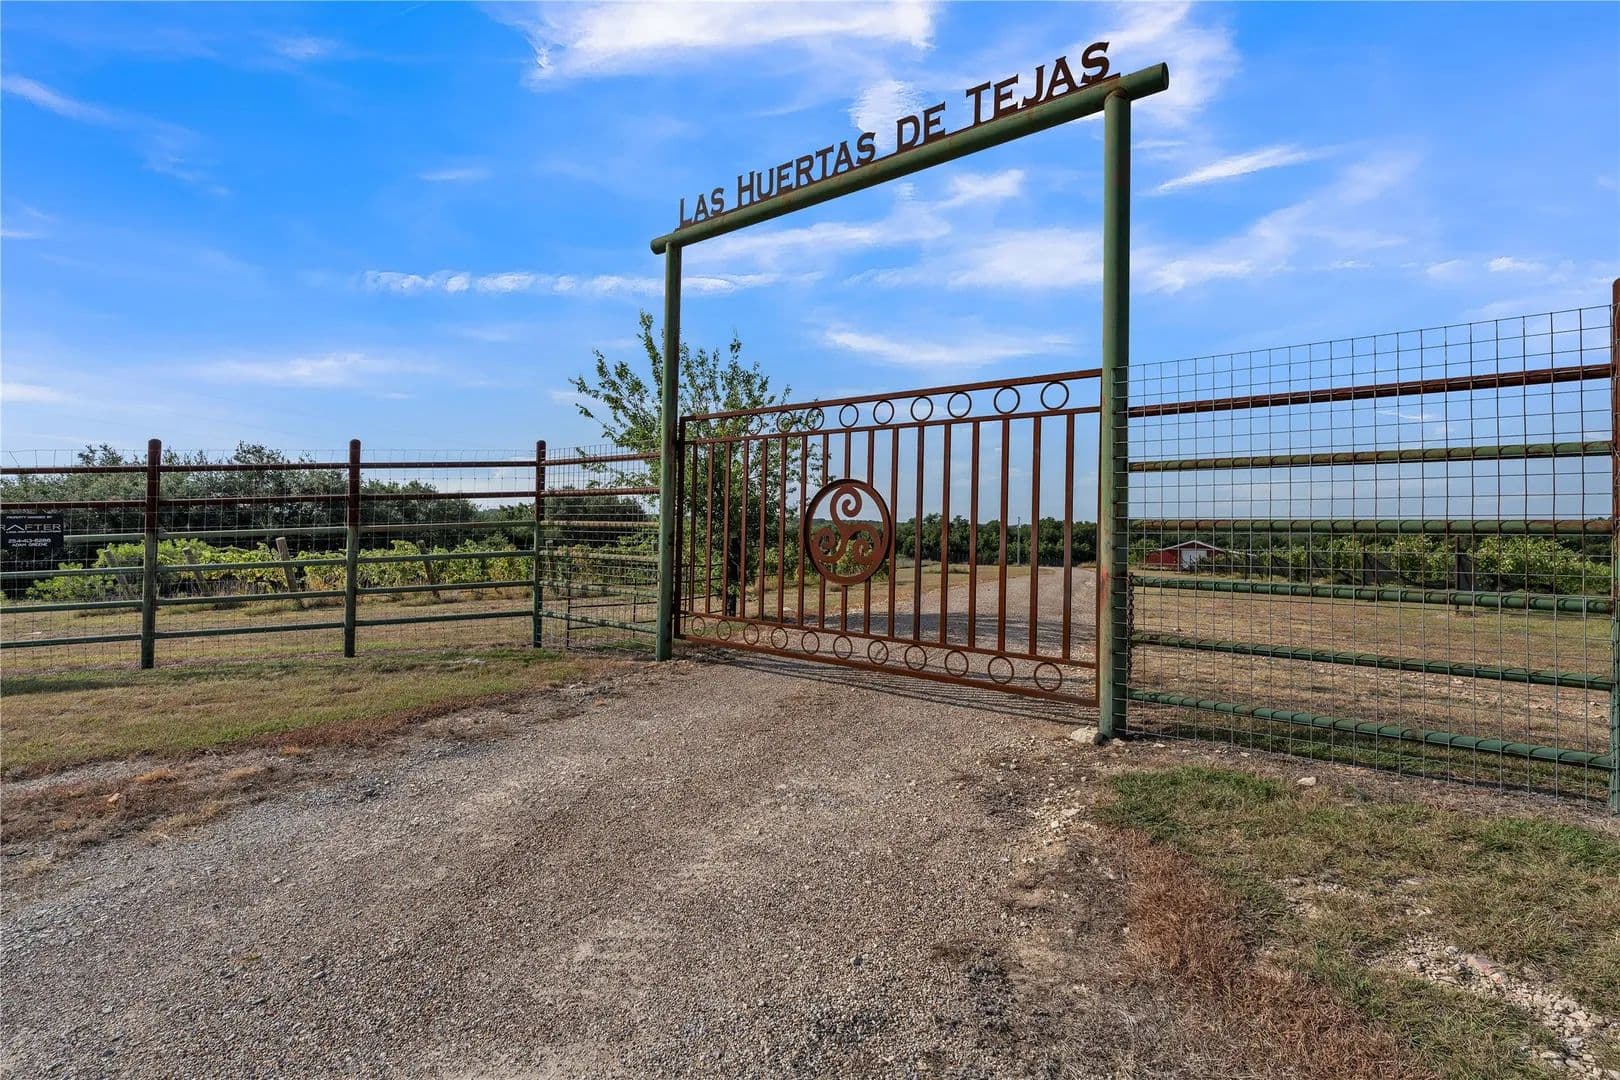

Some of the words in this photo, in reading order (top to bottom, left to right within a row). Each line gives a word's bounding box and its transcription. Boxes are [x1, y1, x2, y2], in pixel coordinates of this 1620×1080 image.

[679, 187, 725, 228] LAS
[737, 132, 876, 209] HUERTAS
[896, 101, 946, 152] DE
[966, 41, 1110, 127] TEJAS
